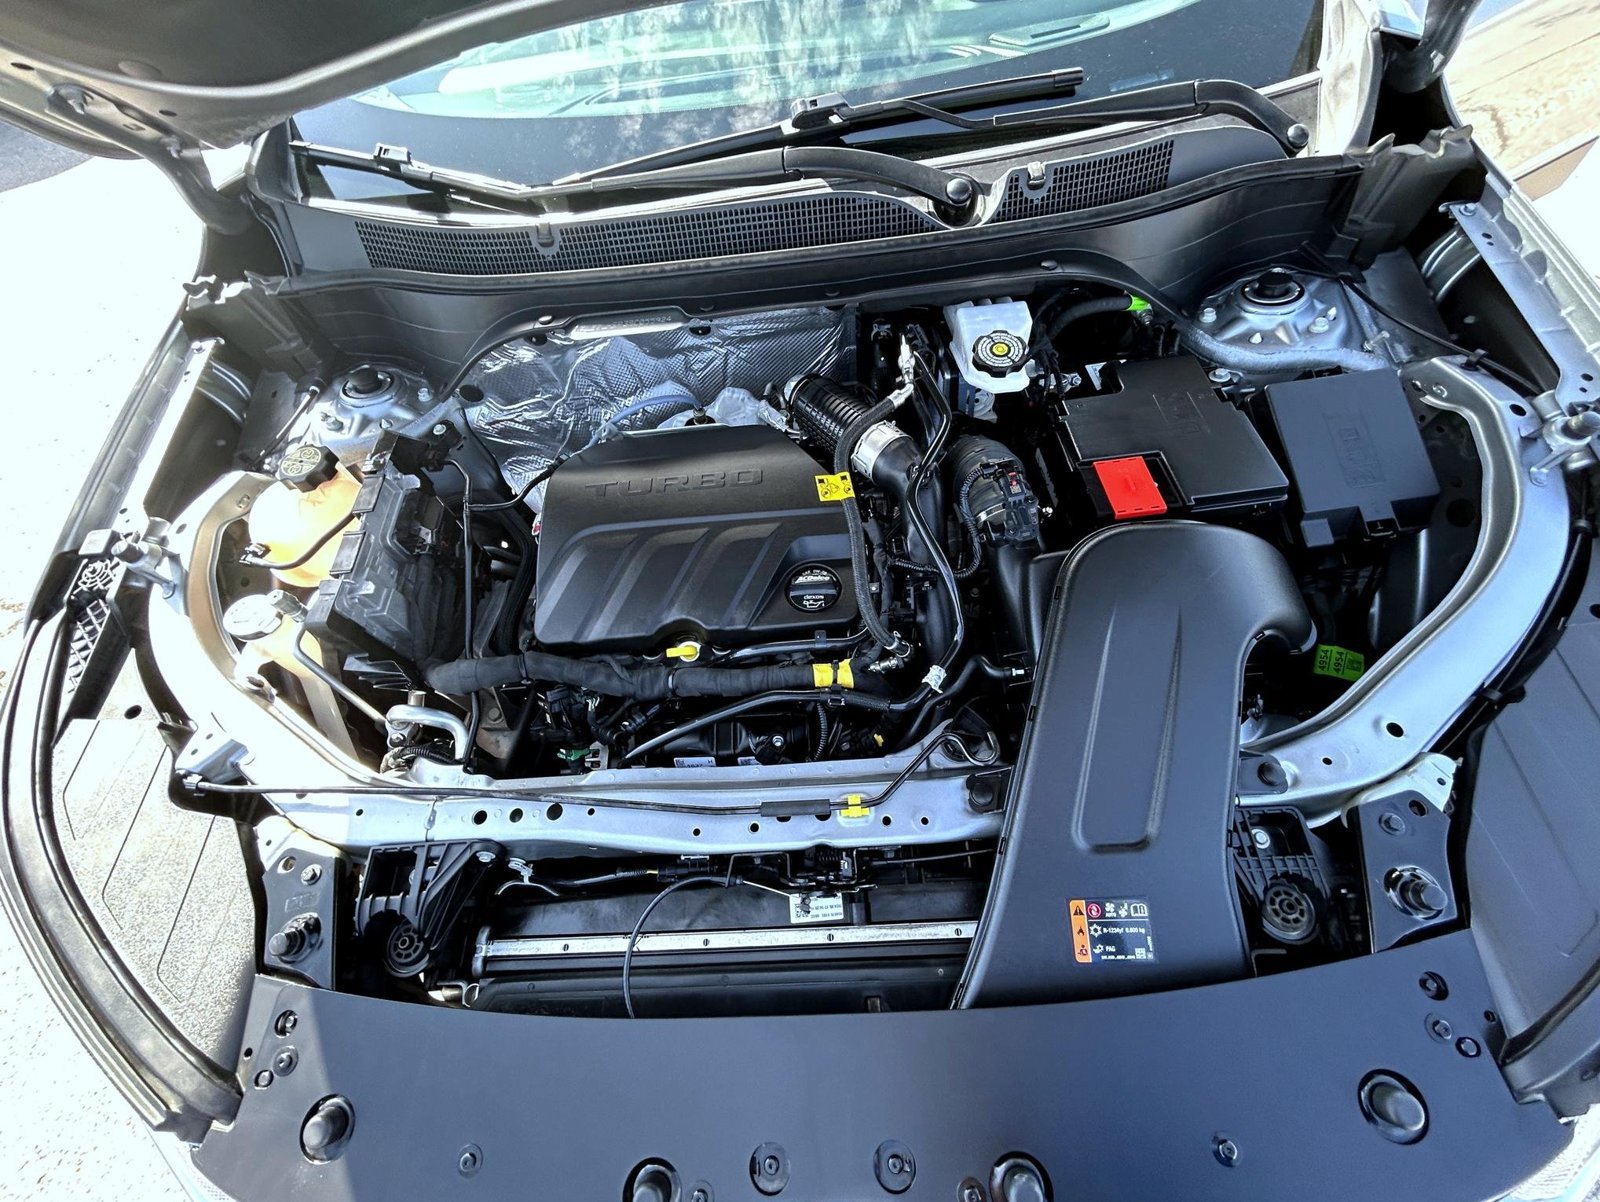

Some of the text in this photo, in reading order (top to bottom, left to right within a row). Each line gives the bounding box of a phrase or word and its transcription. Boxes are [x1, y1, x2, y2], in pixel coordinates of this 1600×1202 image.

[584, 468, 764, 497] TURBO
[795, 575, 830, 583] ACDelco
[1318, 649, 1330, 671] 4954
[1333, 651, 1345, 674] 4954
